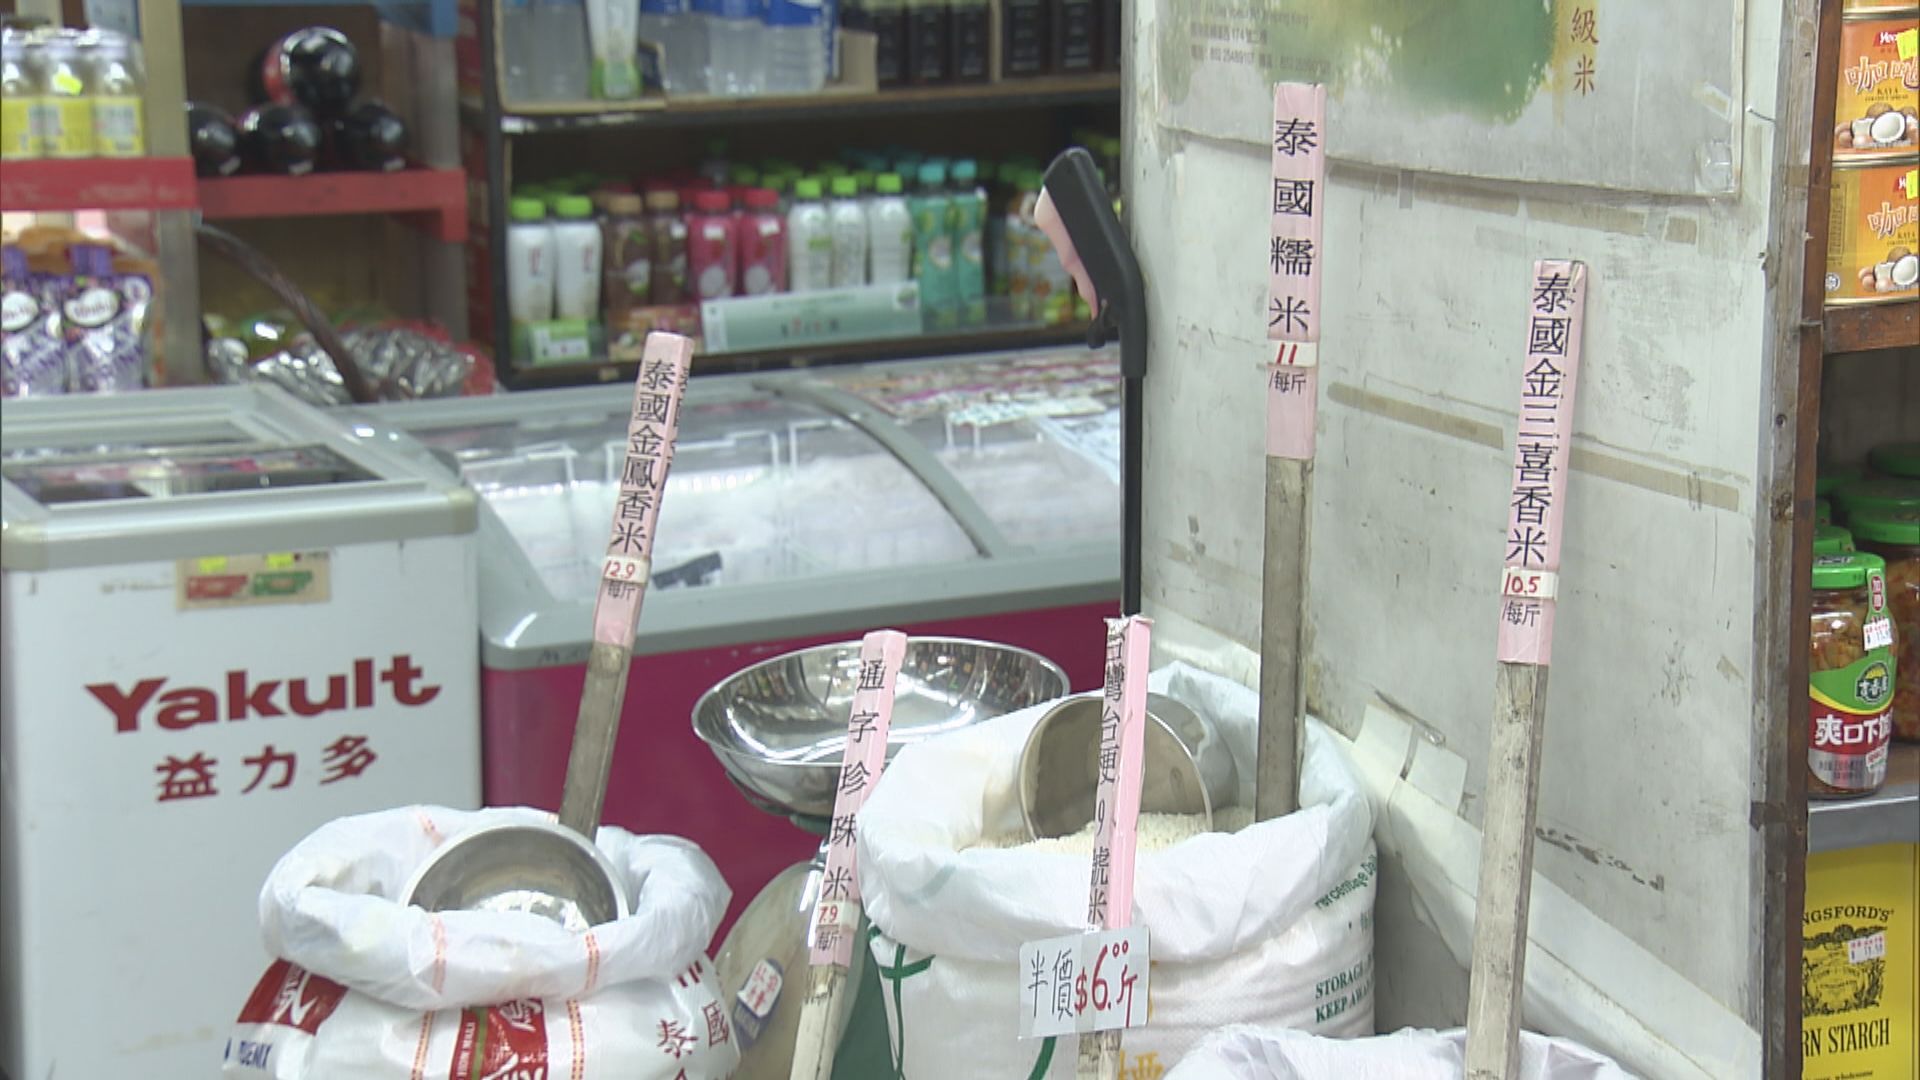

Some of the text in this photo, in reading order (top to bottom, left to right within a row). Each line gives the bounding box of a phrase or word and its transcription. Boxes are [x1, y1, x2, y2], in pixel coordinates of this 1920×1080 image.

[1268, 117, 1318, 333] 泰國糯米
[1505, 272, 1574, 567] 泰國金三喜香米
[611, 359, 677, 554] 泰國金鳳香米
[604, 559, 636, 580] 12.9
[1504, 572, 1541, 597] 10.5
[84, 653, 442, 734] Yakult
[155, 734, 378, 803] 益力多
[823, 658, 887, 901] 通字珍珠米
[818, 904, 839, 924] 7.9
[1315, 995, 1348, 1024] KEEP
[1828, 1018, 1890, 1054] STARCH
